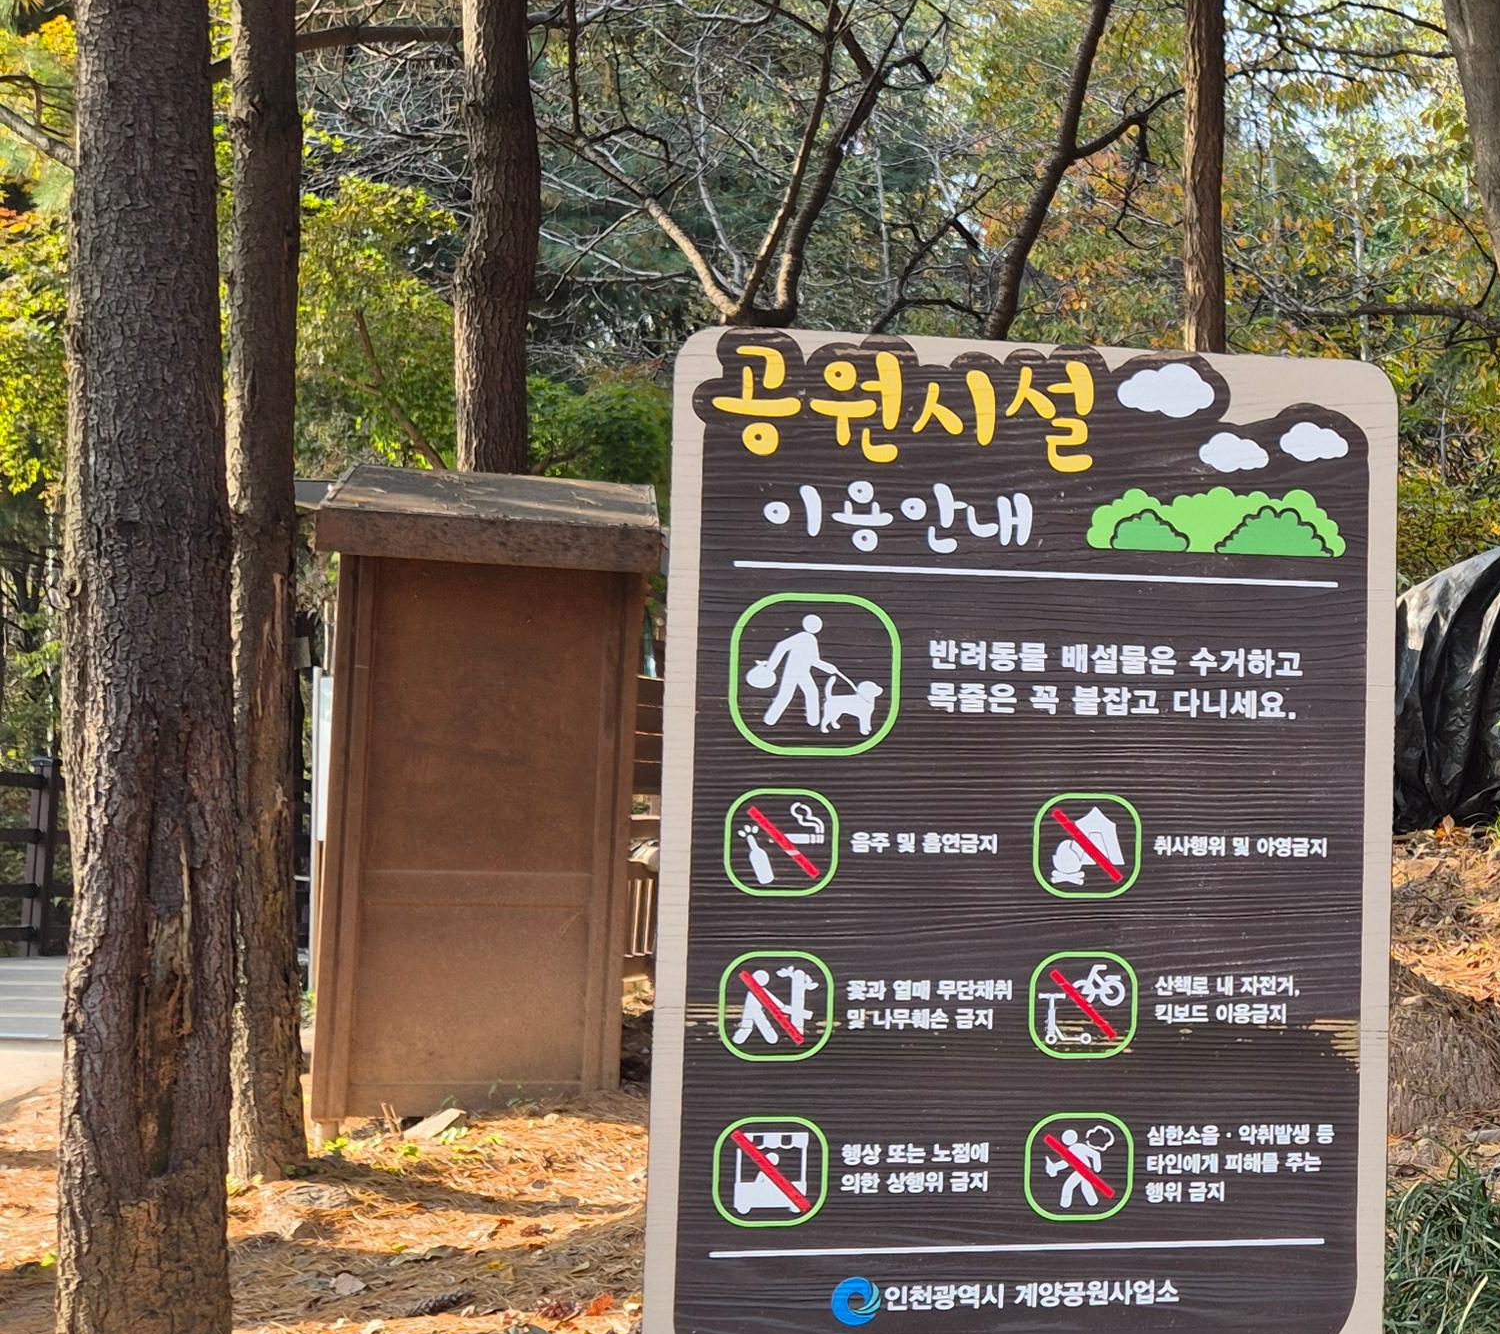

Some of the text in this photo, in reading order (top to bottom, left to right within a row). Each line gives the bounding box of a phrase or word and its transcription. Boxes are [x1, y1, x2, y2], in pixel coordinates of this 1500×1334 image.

[712, 345, 1095, 473] 공원시설
[763, 480, 1033, 554] 이용안내
[929, 639, 1303, 679] 반려동물 배설물은 수거하고
[926, 682, 1297, 720] 목줄은 꼭 붙잡고 다니세요.
[850, 831, 998, 855] 음주 및 흡연금지
[1153, 835, 1328, 858] 취사행위 및 야영금지
[846, 979, 1013, 1001] 꽃과 열매 무단채취
[1154, 974, 1300, 997] 산책로 내 자전거,
[846, 1008, 994, 1030] 및 나무훼손 금지
[1154, 1002, 1287, 1025] 킥보드 이용금지
[1146, 1124, 1221, 1147] 심한소음
[1238, 1123, 1311, 1146] 악취발생
[1315, 1124, 1335, 1144] 등
[841, 1141, 990, 1166] 행상 또는 노점에
[1146, 1151, 1322, 1175] 타인에게 피해를 주는
[840, 1170, 989, 1195] 의한 상행위 금지
[1145, 1180, 1225, 1203] 행위 금지
[884, 1279, 1180, 1311] 인천광역시 계양공원사업소
